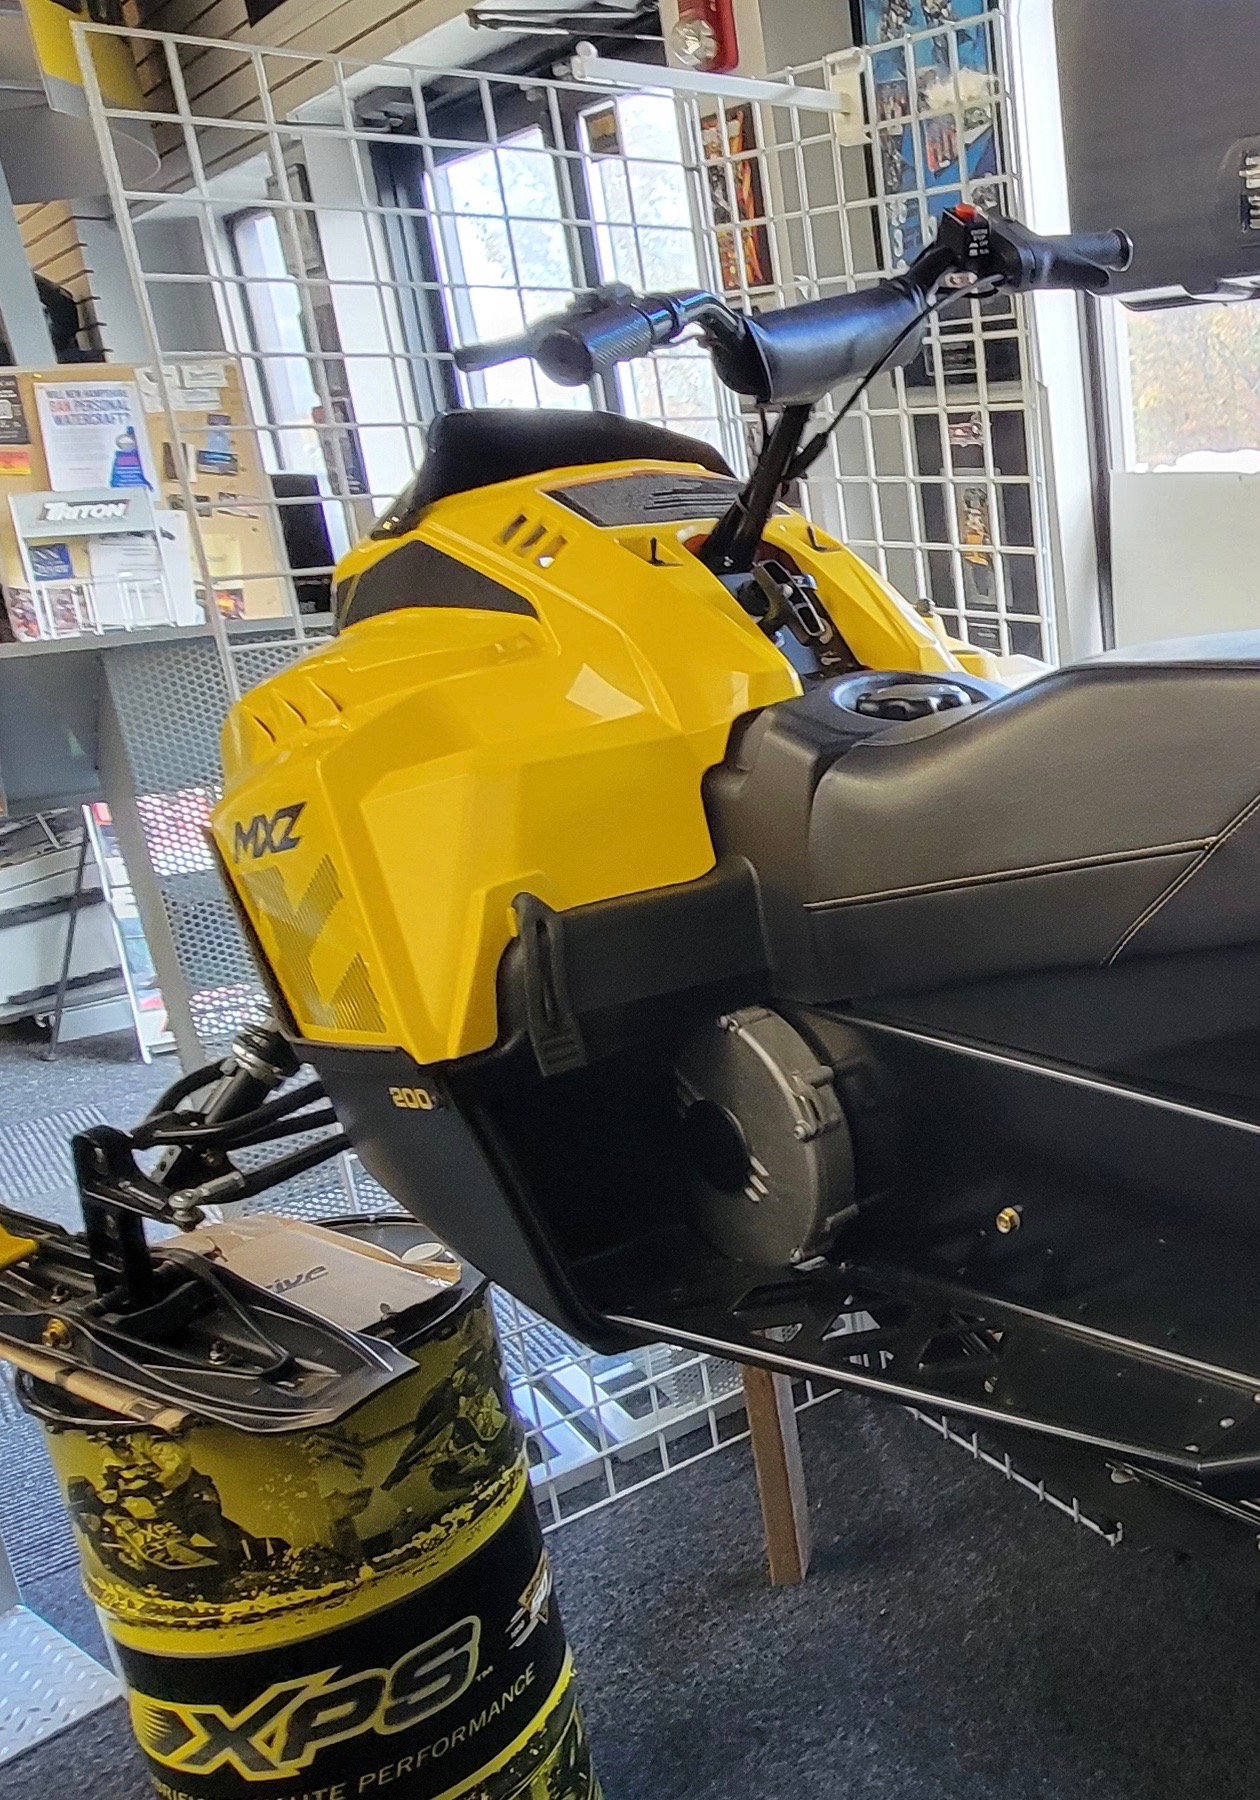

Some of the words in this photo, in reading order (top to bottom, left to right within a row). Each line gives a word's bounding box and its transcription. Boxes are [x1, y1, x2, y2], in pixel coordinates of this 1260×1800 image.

[44, 502, 127, 521] TRITON
[234, 801, 307, 863] MXZ
[388, 1086, 436, 1111] 200
[135, 1614, 482, 1782] XPS
[358, 1661, 535, 1794] PERFORMANCE
